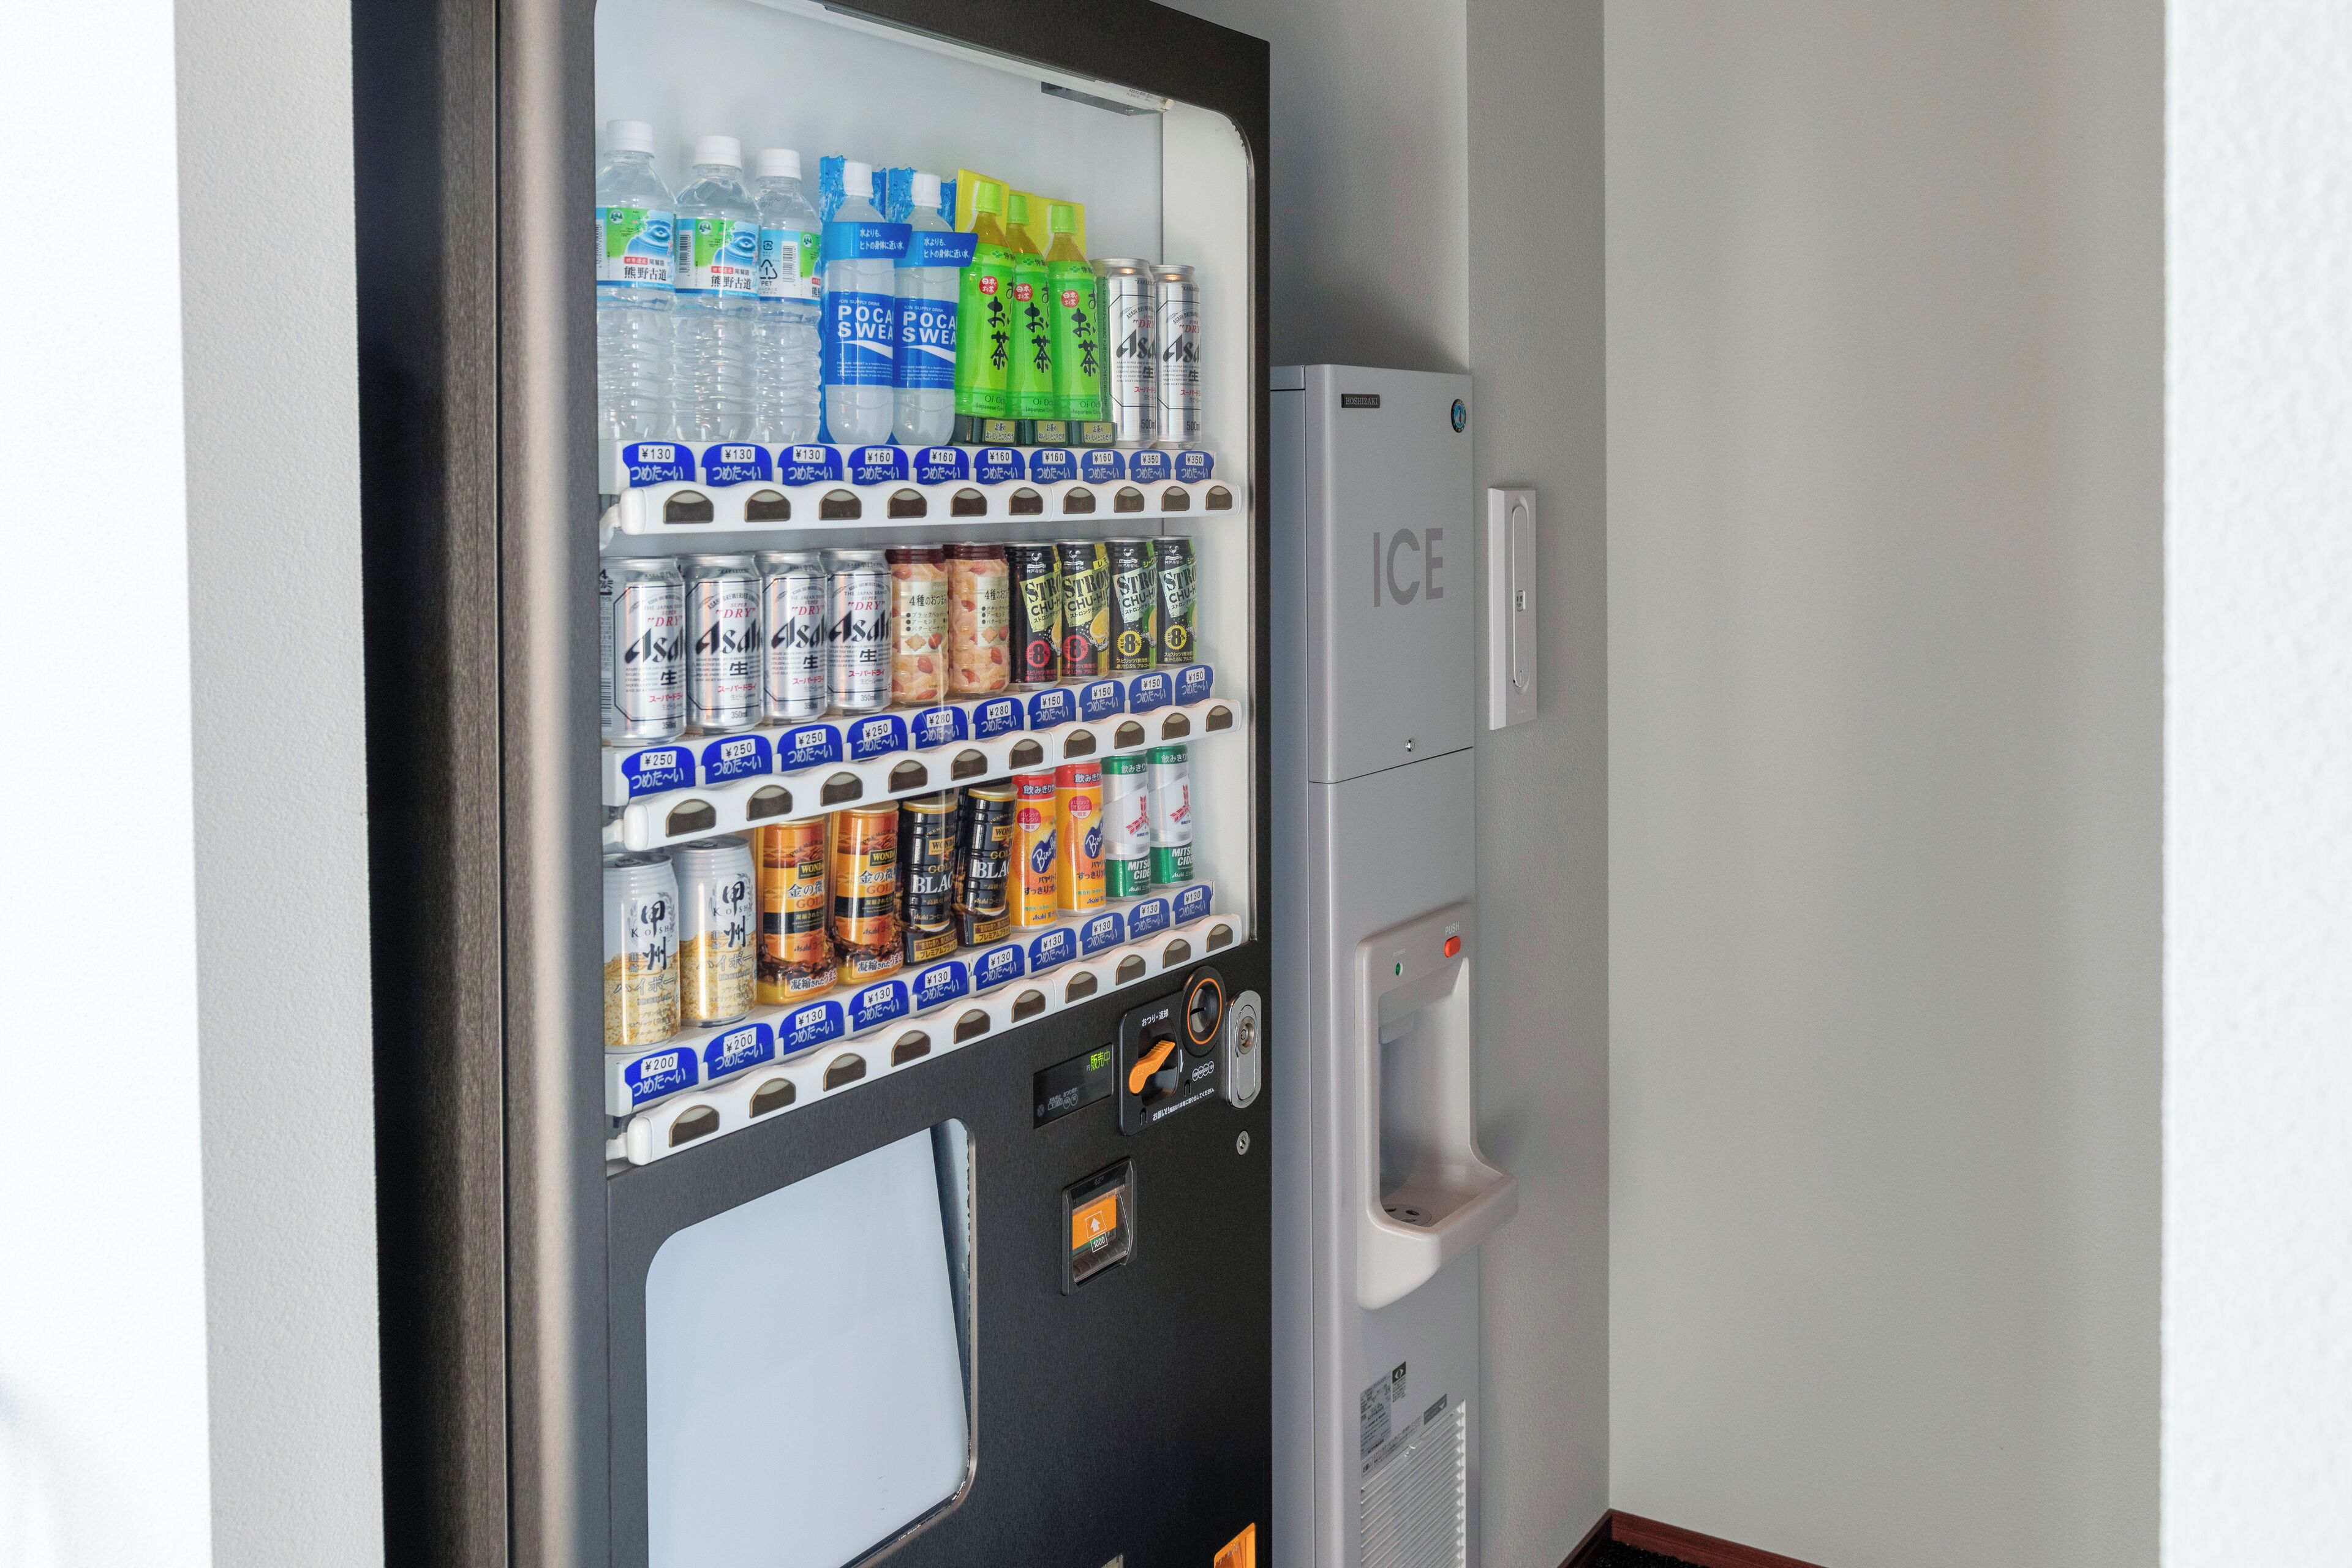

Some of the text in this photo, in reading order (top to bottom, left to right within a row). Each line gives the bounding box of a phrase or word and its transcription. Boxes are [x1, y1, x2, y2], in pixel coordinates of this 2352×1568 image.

[859, 228, 881, 238] 水よりも、
[859, 240, 905, 251] ヒトの身体に近い水。
[924, 249, 970, 258] ヒトの身体に近い水。
[624, 266, 666, 281] 熊野古道
[711, 275, 752, 290] 熊野古道
[1142, 366, 1154, 379] 生
[1188, 369, 1199, 382] 生
[642, 448, 671, 459] ¥130
[725, 449, 752, 459] ¥130
[796, 449, 820, 459] ¥130
[867, 452, 890, 462] ¥160
[932, 451, 953, 462] ¥160
[990, 452, 1009, 461] ¥160
[1045, 453, 1063, 461] ¥160
[1094, 453, 1111, 462] ¥160
[1187, 456, 1202, 464] ¥350
[1373, 527, 1444, 608] ICE
[803, 655, 818, 669] 生
[859, 649, 877, 662] 生
[729, 661, 748, 676] 生
[848, 669, 885, 677] スーパードライ
[660, 669, 677, 685] 生
[1188, 671, 1204, 682] ¥150
[717, 683, 757, 693] スーパードライ
[1144, 679, 1160, 688] ¥150
[1093, 687, 1111, 698] ¥150
[1042, 696, 1061, 706] ¥150
[989, 705, 1009, 717] ¥280
[929, 714, 950, 725] ¥280
[865, 723, 888, 738] ¥250
[799, 731, 823, 745] ¥250
[726, 742, 752, 758] ¥250
[644, 754, 673, 766] ¥250
[1186, 891, 1201, 902] ¥130
[722, 881, 747, 948] 甲州
[1142, 904, 1158, 915] ¥130
[1093, 921, 1111, 933] ¥130
[1445, 921, 1460, 936] PUSH
[641, 900, 668, 971] 甲州
[1043, 935, 1062, 949] ¥130
[921, 942, 956, 958] プレミアムブラック
[858, 954, 902, 973] 凝縮されたうまさ
[990, 952, 1010, 967] ¥130
[927, 971, 948, 985] ¥130
[868, 987, 891, 1004] ¥130
[798, 1009, 823, 1026] ¥130
[1142, 1009, 1169, 1027] おつり・返却
[726, 1034, 753, 1053] ¥200
[645, 1056, 674, 1072] ¥200
[1090, 1049, 1110, 1071] 販売中
[1093, 1236, 1106, 1248] 1000
